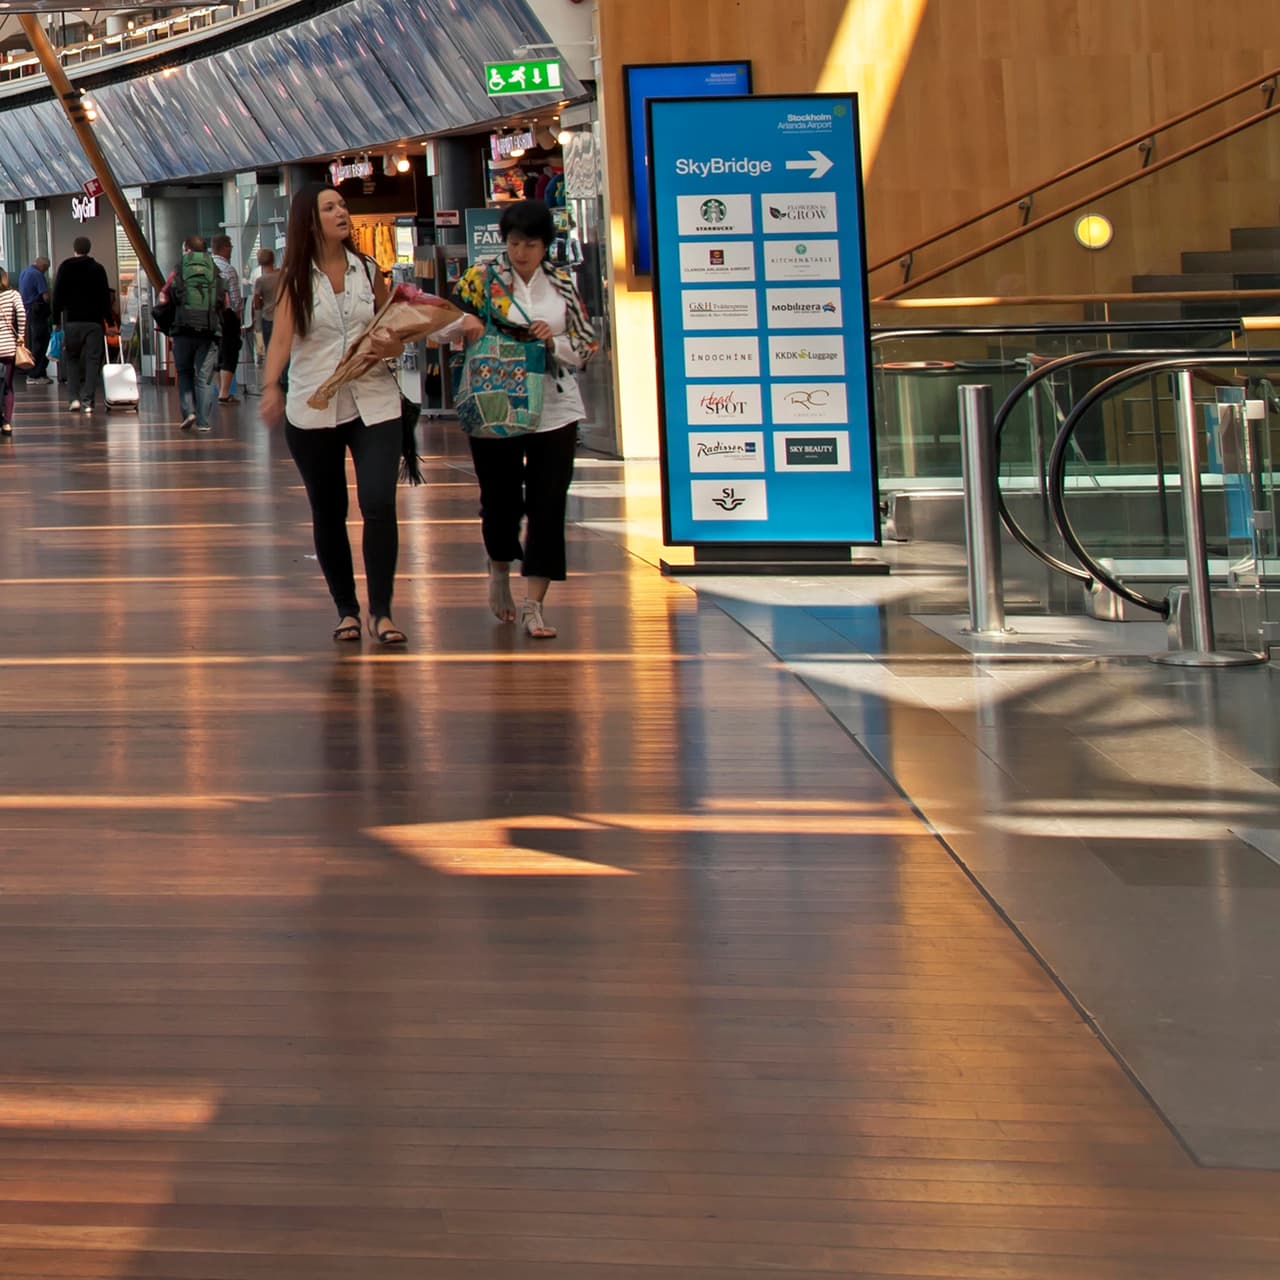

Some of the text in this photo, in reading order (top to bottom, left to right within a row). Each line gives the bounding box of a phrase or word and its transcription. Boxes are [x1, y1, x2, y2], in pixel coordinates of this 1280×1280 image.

[787, 113, 832, 122] Stockholm
[777, 121, 833, 130] Arlanda Airport
[676, 157, 772, 177] SkyBridge
[787, 210, 827, 220] GROW
[772, 302, 821, 312] Mobilizera
[808, 351, 838, 361] Luggage
[700, 391, 735, 407] Head
[705, 402, 747, 415] SPOT
[697, 441, 744, 458] Radisson
[804, 445, 833, 453] BEAUTY
[722, 487, 735, 499] SJ
